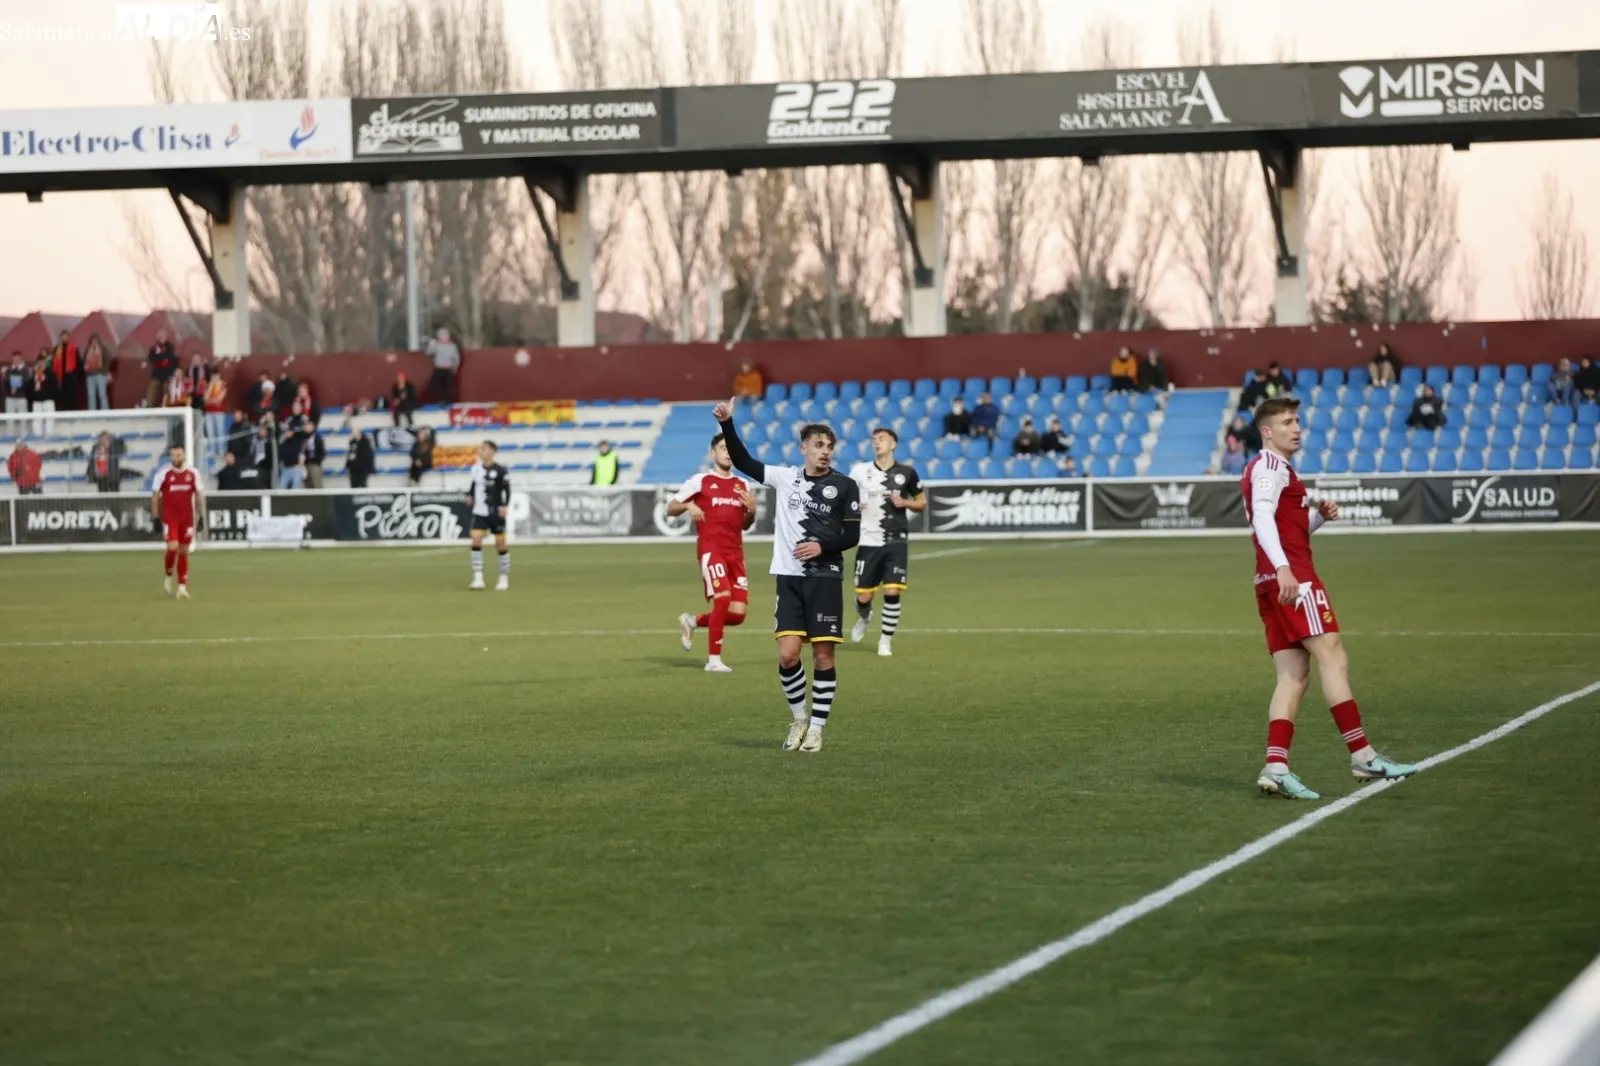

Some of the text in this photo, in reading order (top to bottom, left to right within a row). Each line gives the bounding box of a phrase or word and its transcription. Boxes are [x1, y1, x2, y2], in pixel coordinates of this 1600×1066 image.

[1379, 59, 1545, 100] MIRSAN
[768, 79, 897, 121] 222
[1446, 95, 1545, 114] SERVICIOS
[463, 101, 657, 123] SUMINISTROS DE OFICINA
[480, 123, 640, 144] Y MATERIAL ESCOLAR
[766, 117, 892, 138] GoldenCar
[1, 124, 212, 157] Electro-Clisa
[27, 510, 119, 532] MORETA
[709, 562, 726, 579] 10
[1315, 589, 1330, 610] 4
